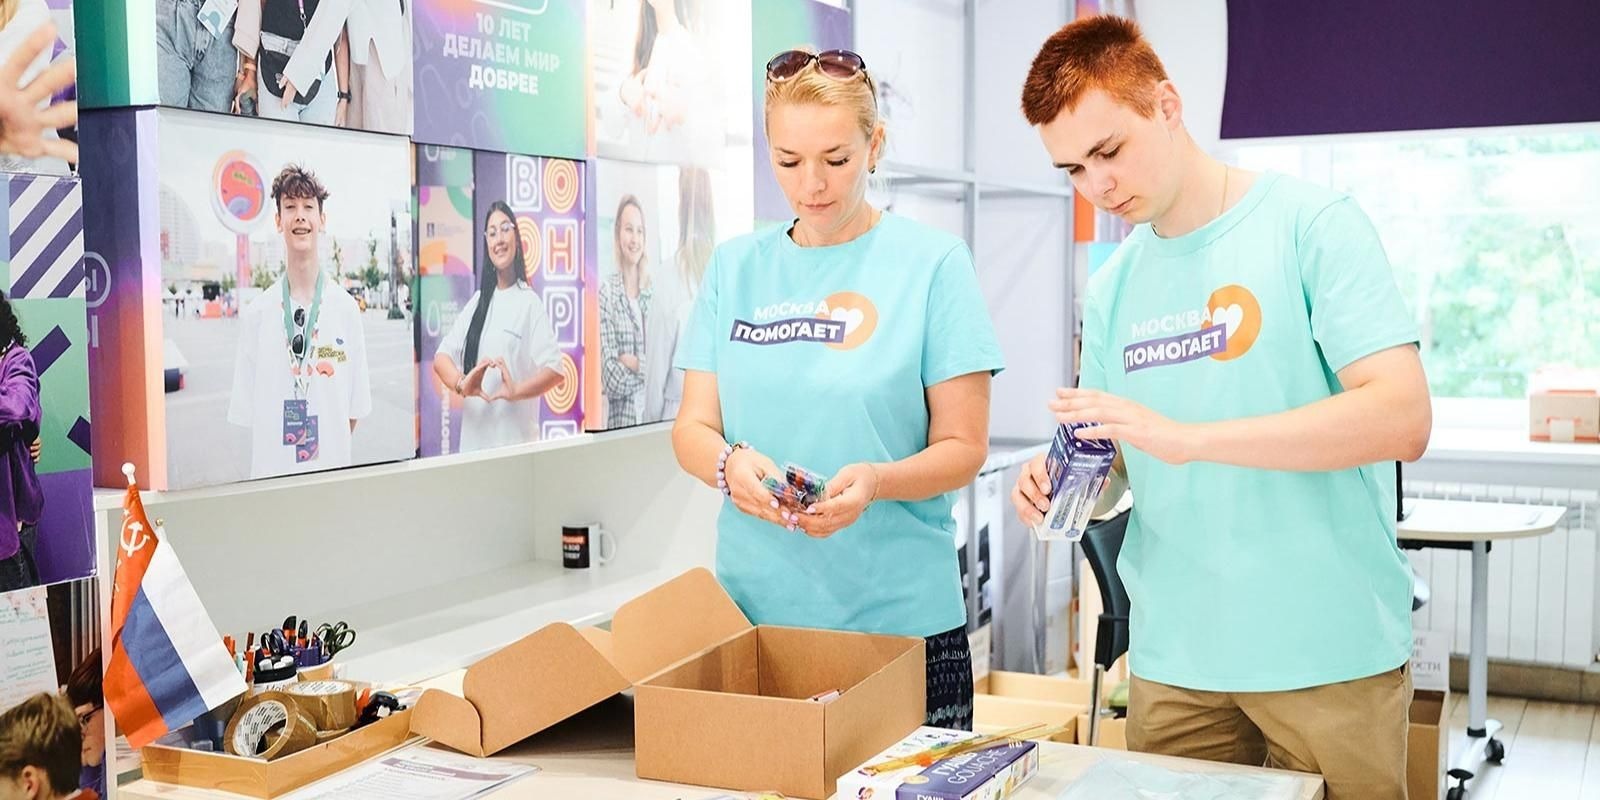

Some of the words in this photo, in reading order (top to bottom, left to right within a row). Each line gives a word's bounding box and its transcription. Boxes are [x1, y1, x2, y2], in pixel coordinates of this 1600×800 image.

[475, 12, 495, 36] 10
[498, 17, 532, 43] ЛЕТ
[443, 33, 520, 66] ДЕЛАЕМ
[524, 47, 561, 73] МИР
[469, 63, 540, 95] ДОБРЕЕ
[753, 300, 830, 321] МОСКВА
[1131, 304, 1212, 338] МОСКВА
[735, 322, 841, 343] ПОМОГАЕТ
[1124, 329, 1222, 369] ПОМОГАЕТ
[947, 749, 1008, 785] GOUACHE
